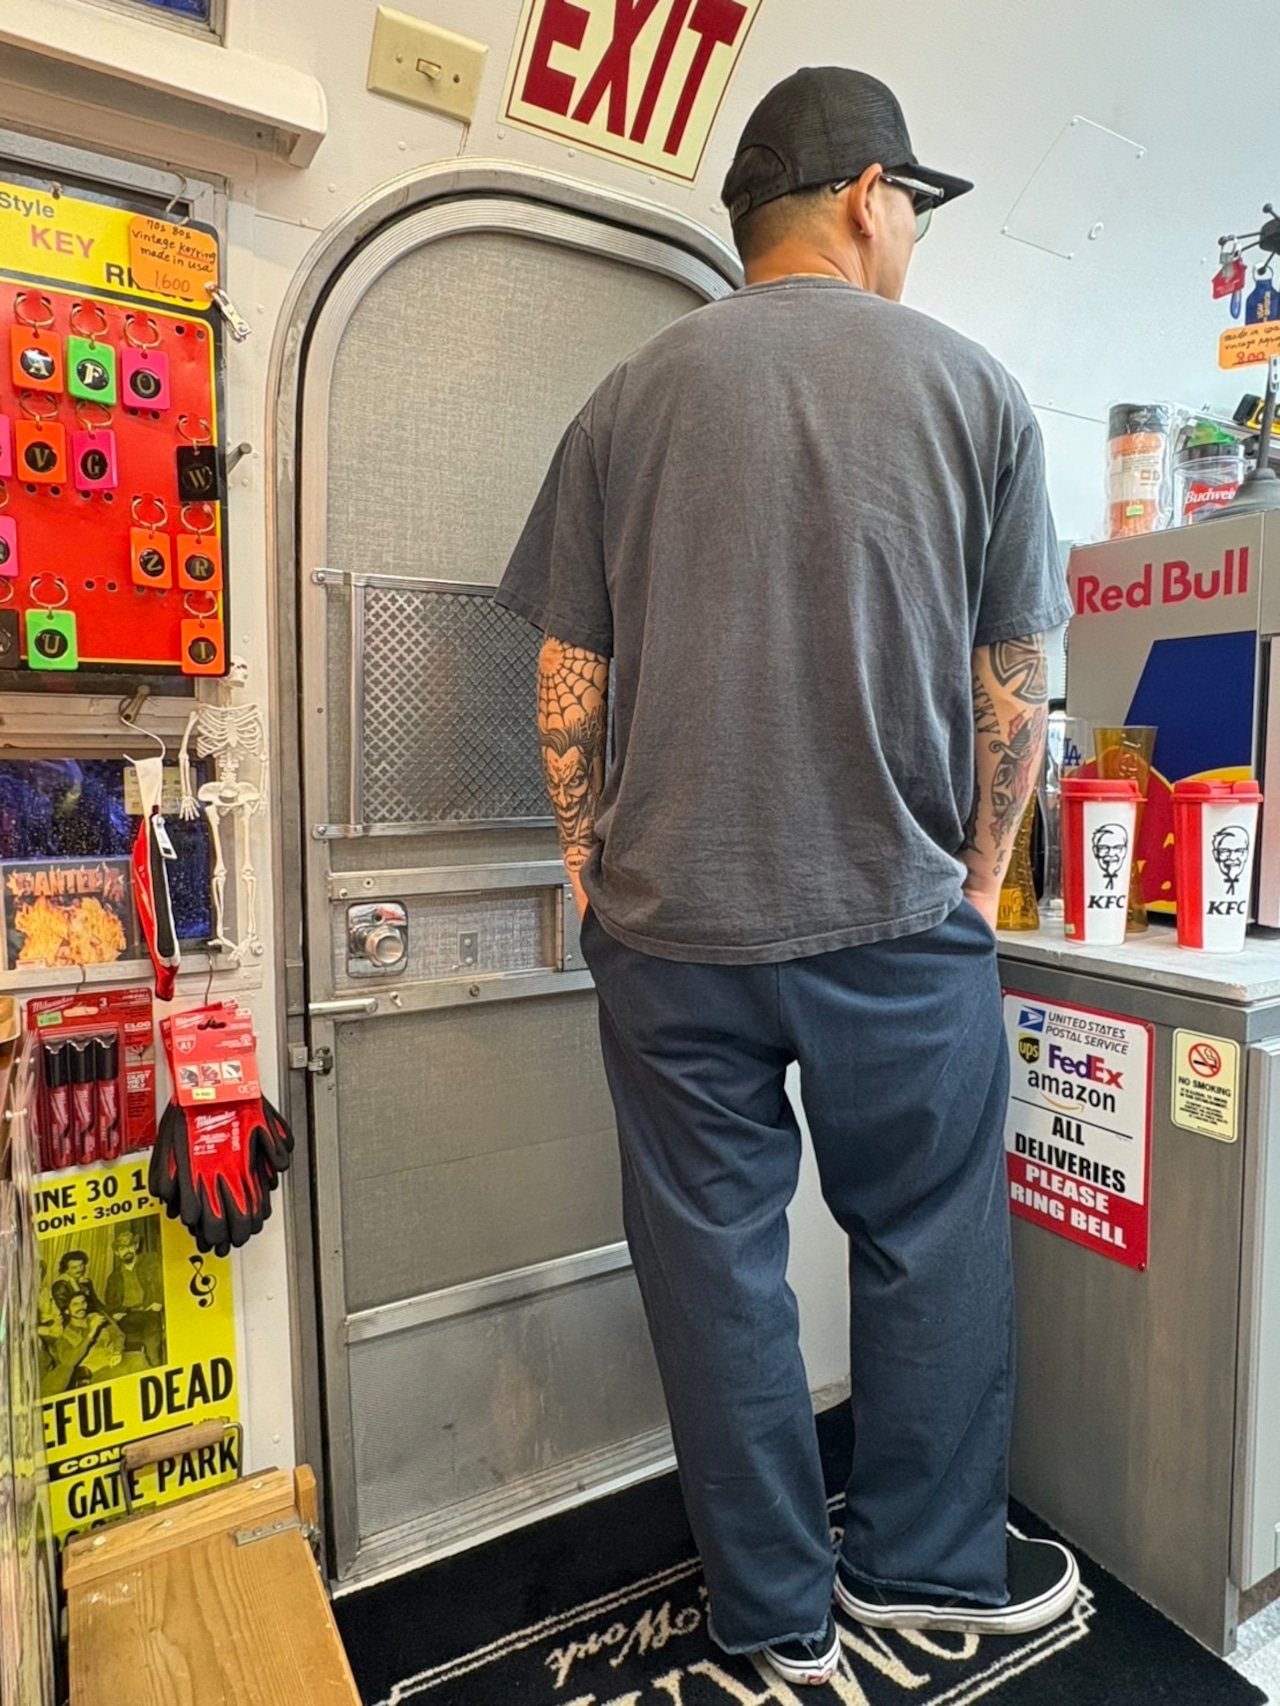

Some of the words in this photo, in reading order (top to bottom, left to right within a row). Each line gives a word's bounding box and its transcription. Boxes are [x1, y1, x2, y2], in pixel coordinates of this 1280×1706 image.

[521, 0, 748, 156] EXIT
[0, 191, 55, 218] Style
[30, 224, 95, 259] KEY
[132, 229, 176, 250] vintage
[179, 241, 217, 265] keyring
[140, 246, 170, 262] made
[172, 256, 184, 266] in
[188, 261, 213, 273] usa
[28, 357, 50, 376] A
[83, 363, 103, 385] F
[33, 447, 50, 468] V
[86, 453, 101, 475] G
[188, 469, 207, 489] W
[195, 557, 208, 577] R
[1076, 563, 1153, 616] Red
[1162, 546, 1250, 604] Bull
[42, 634, 60, 654] U
[1087, 895, 1126, 909] KFC
[1206, 900, 1246, 915] KFC
[99, 997, 108, 1007] 3
[1048, 1012, 1086, 1030] UNITED
[1088, 1022, 1126, 1039] STATES
[1019, 1041, 1039, 1060] ups
[1045, 1025, 1082, 1043] POSTAL
[1085, 1035, 1129, 1055] SERVICE
[1048, 1043, 1124, 1090] FedEx
[1028, 1070, 1116, 1113] amazon
[1178, 1076, 1190, 1086] NO
[1192, 1080, 1232, 1098] SMOKING
[1052, 1115, 1085, 1146] ALL
[1015, 1132, 1126, 1194] DELIVERIES
[86, 1175, 118, 1202] 30
[1026, 1163, 1109, 1215] PLEASE
[94, 1201, 132, 1219] 3:00
[1010, 1181, 1065, 1222] RING
[1070, 1207, 1127, 1249] BELL
[140, 1357, 233, 1422] DEAD
[59, 1445, 127, 1474] CON
[68, 1465, 144, 1519] GATE
[157, 1436, 238, 1492] PARK
[545, 1601, 672, 1689] Work
